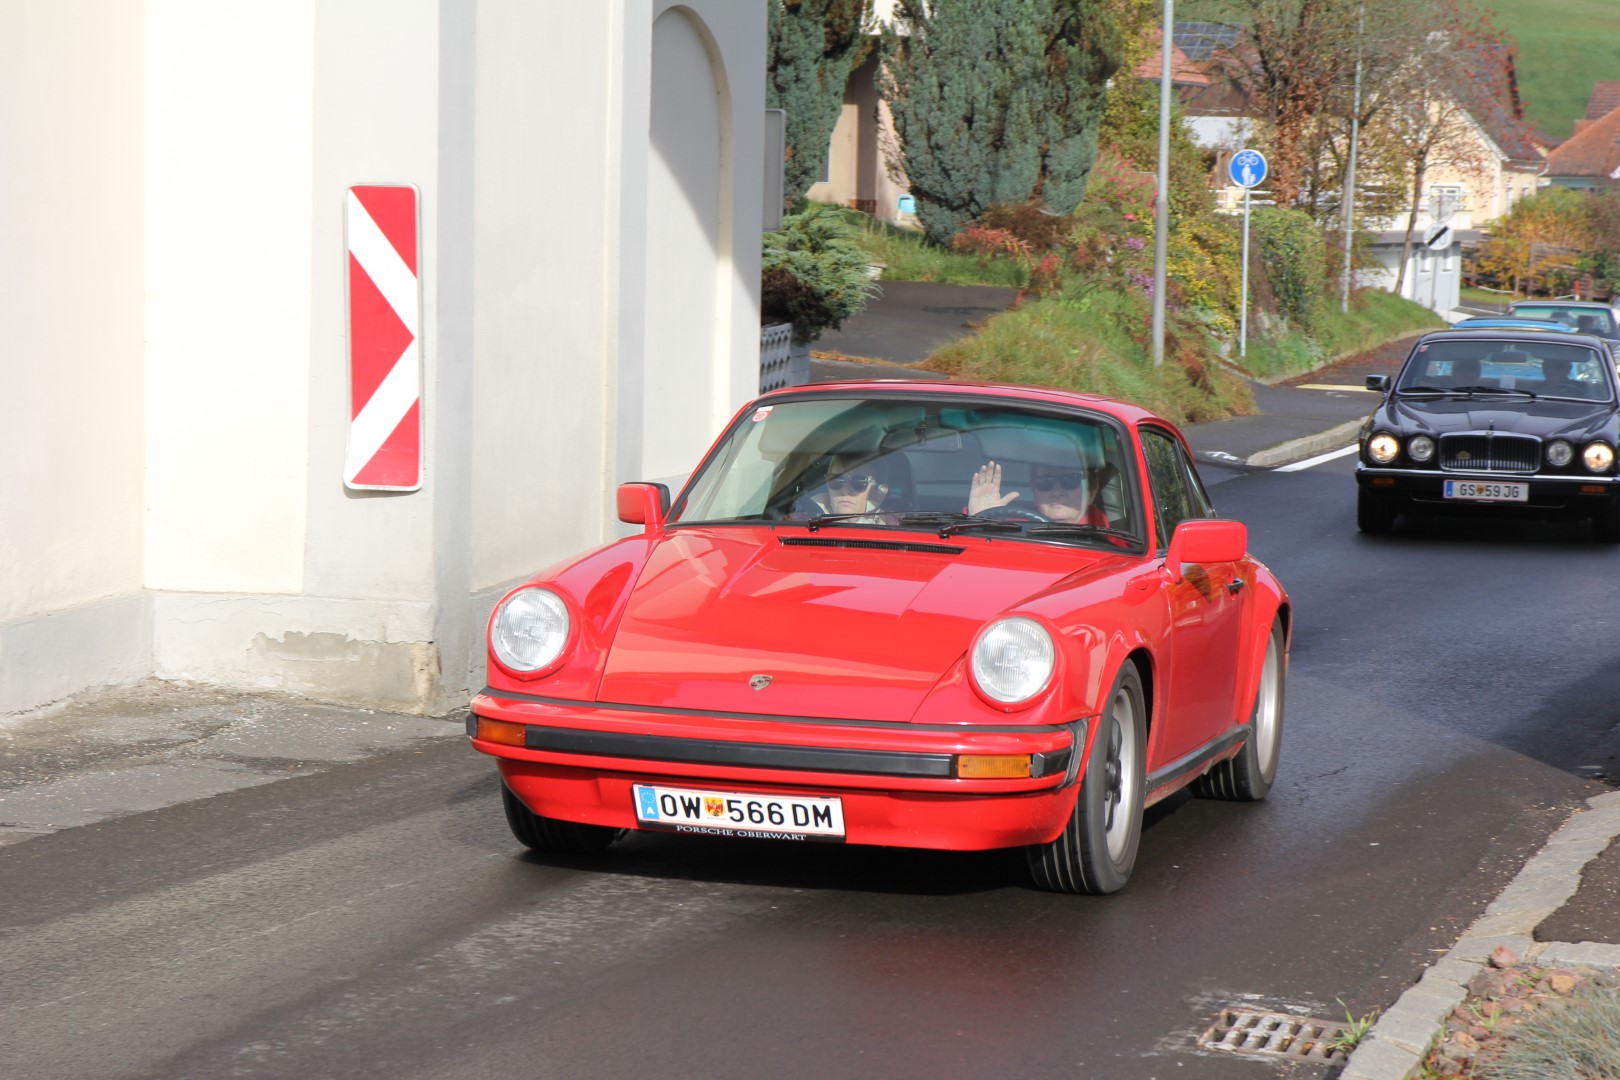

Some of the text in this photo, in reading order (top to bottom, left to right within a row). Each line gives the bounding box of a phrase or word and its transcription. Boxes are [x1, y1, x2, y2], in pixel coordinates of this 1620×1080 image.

[1460, 484, 1476, 496] GS
[1485, 485, 1501, 497] 59
[1503, 486, 1520, 498] JG
[646, 806, 655, 815] A
[660, 794, 833, 828] OW 566 DM
[676, 825, 807, 841] PORSCHE OBERWART
